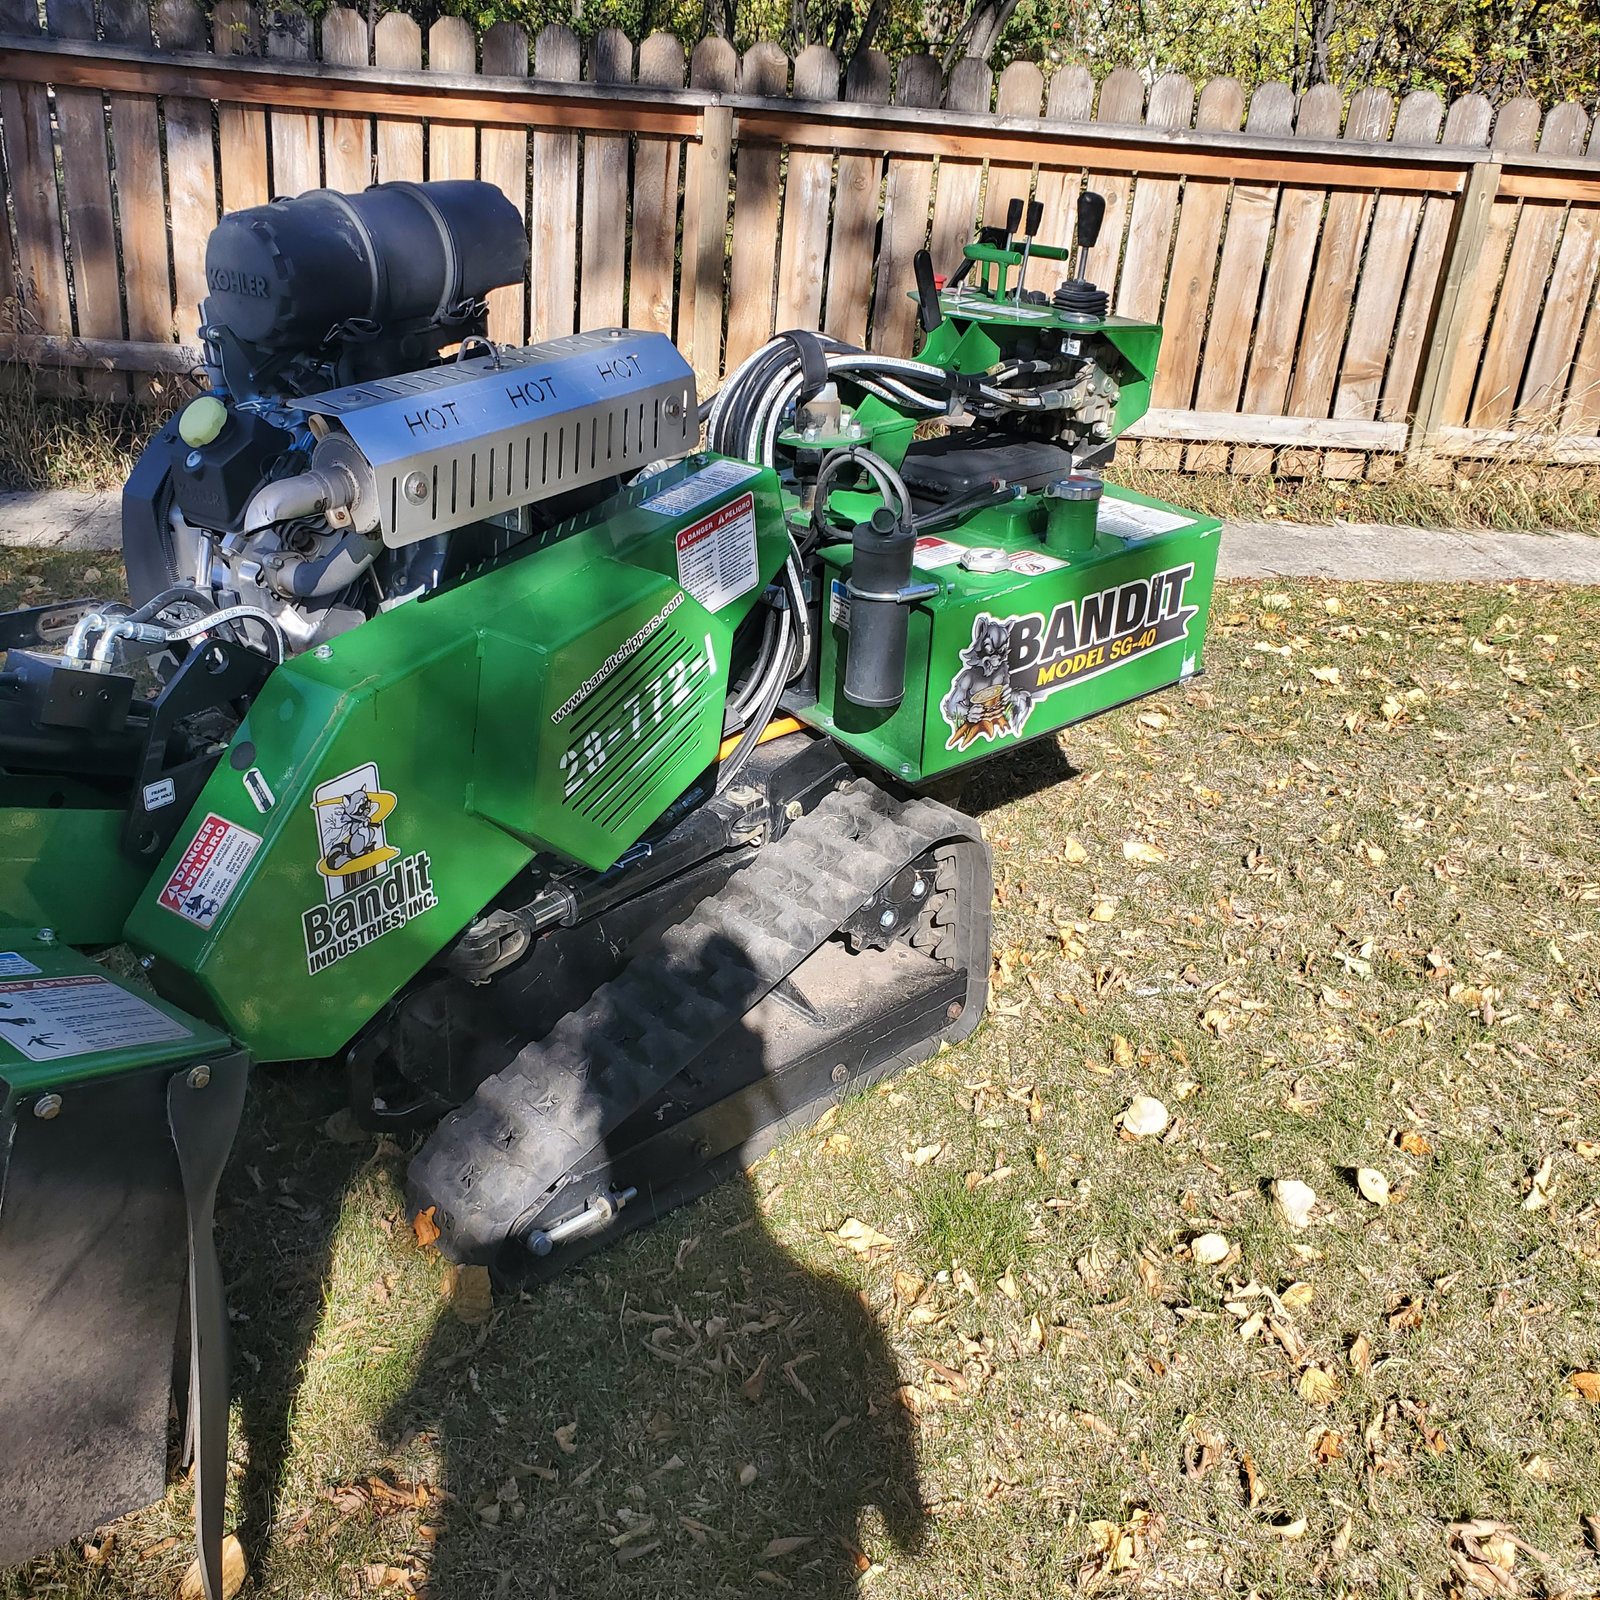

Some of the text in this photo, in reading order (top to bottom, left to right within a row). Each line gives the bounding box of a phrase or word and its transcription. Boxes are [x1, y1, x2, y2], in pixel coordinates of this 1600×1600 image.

[208, 267, 269, 299] KOHLER
[596, 354, 643, 383] HOT
[506, 377, 559, 409] HOT
[404, 402, 460, 437] HOT
[687, 500, 751, 541] DANGER PELIGRO
[1009, 566, 1193, 671] BANDIT
[552, 591, 684, 724] www.banditchippers.com
[1036, 628, 1156, 687] MODEL SG-40
[175, 823, 215, 882] DANGER
[184, 825, 225, 888] PELIGRO
[229, 842, 249, 874] SUS MANOS
[199, 867, 213, 888] MOVING
[211, 880, 221, 895] KEEP
[215, 878, 228, 897] HANDS
[302, 852, 432, 955] Bandit
[309, 892, 438, 974] INDUSTRIES, INC.
